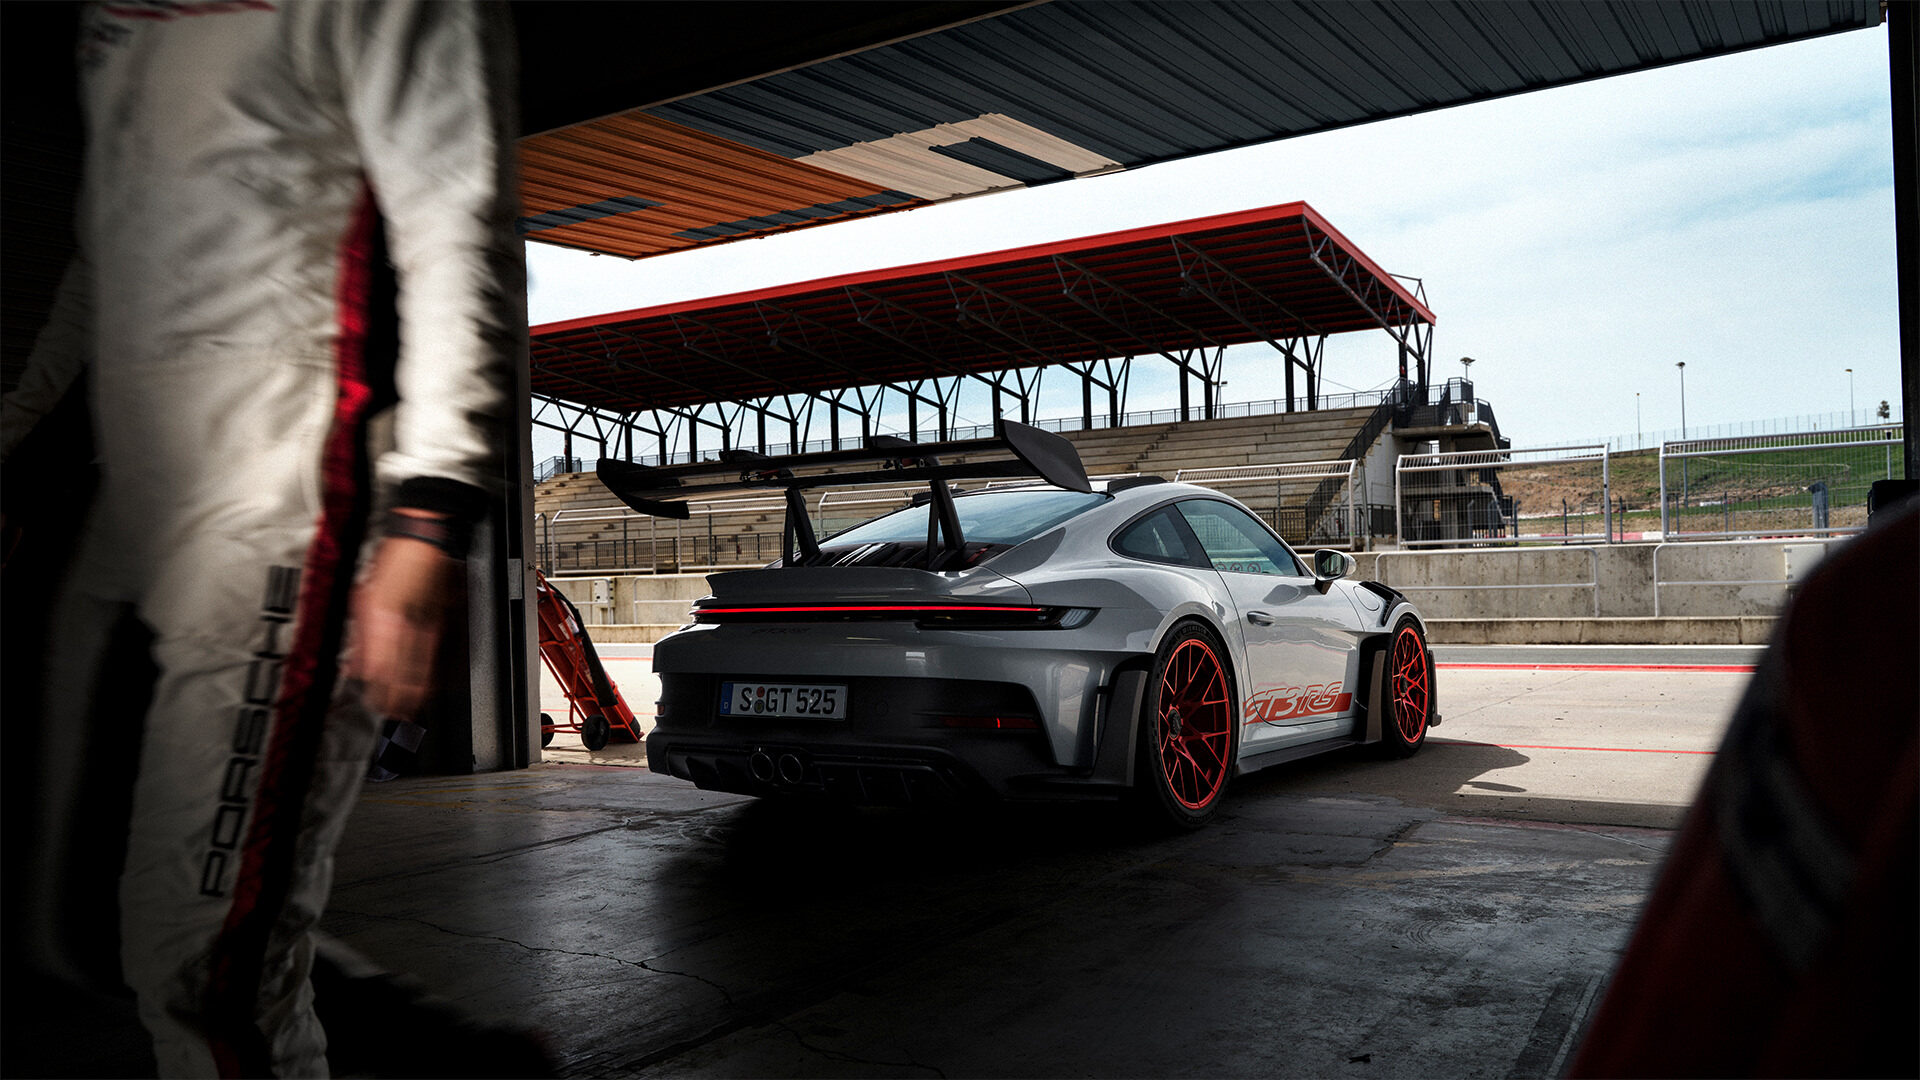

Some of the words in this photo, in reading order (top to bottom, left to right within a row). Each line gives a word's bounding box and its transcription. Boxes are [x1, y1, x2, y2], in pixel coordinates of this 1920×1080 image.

[200, 565, 301, 897] PORSCHE
[740, 687, 752, 711] S
[766, 688, 792, 713] GT
[796, 689, 837, 714] 525
